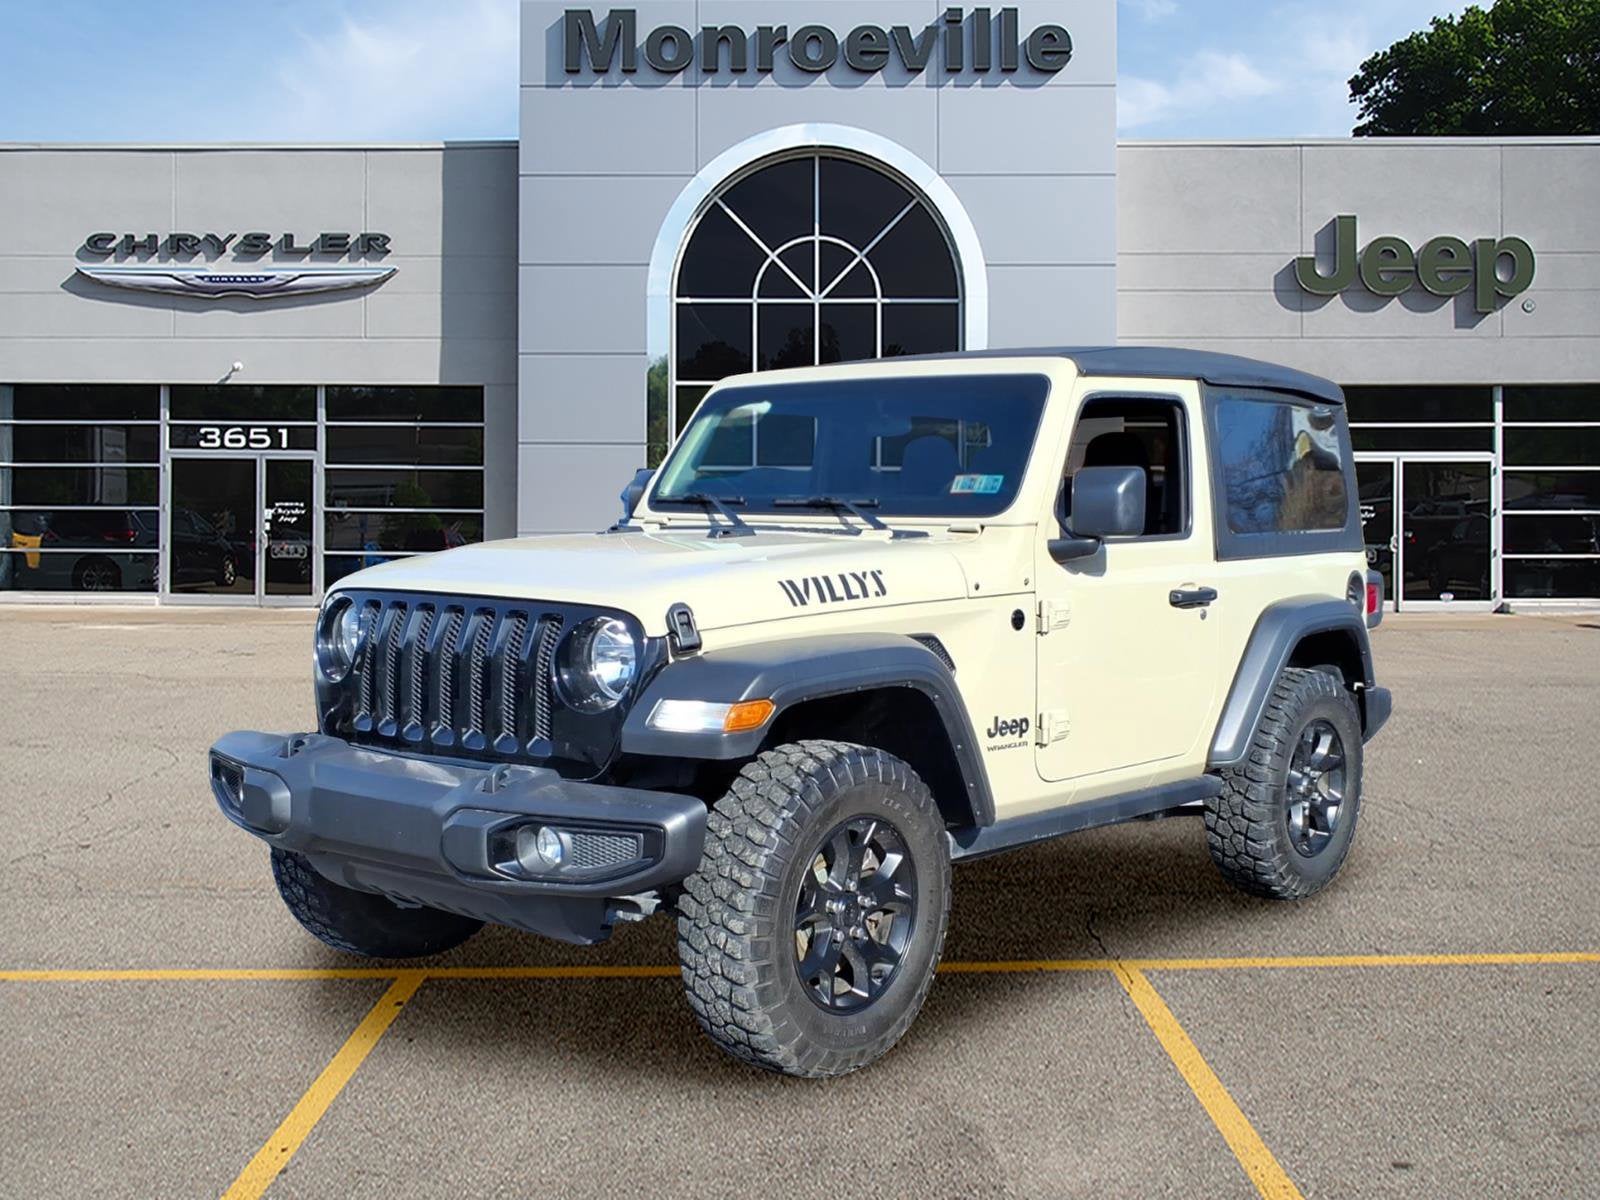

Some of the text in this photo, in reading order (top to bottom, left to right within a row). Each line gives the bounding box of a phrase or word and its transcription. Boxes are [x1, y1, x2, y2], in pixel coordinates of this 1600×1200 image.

[563, 7, 1073, 73] Monroeville
[85, 232, 392, 255] CHRYSLER
[1295, 215, 1535, 313] Jeep
[199, 427, 288, 448] 3651
[777, 569, 887, 607] WILLYS
[987, 715, 1029, 738] Jeep
[987, 740, 1029, 752] WRANGLER
